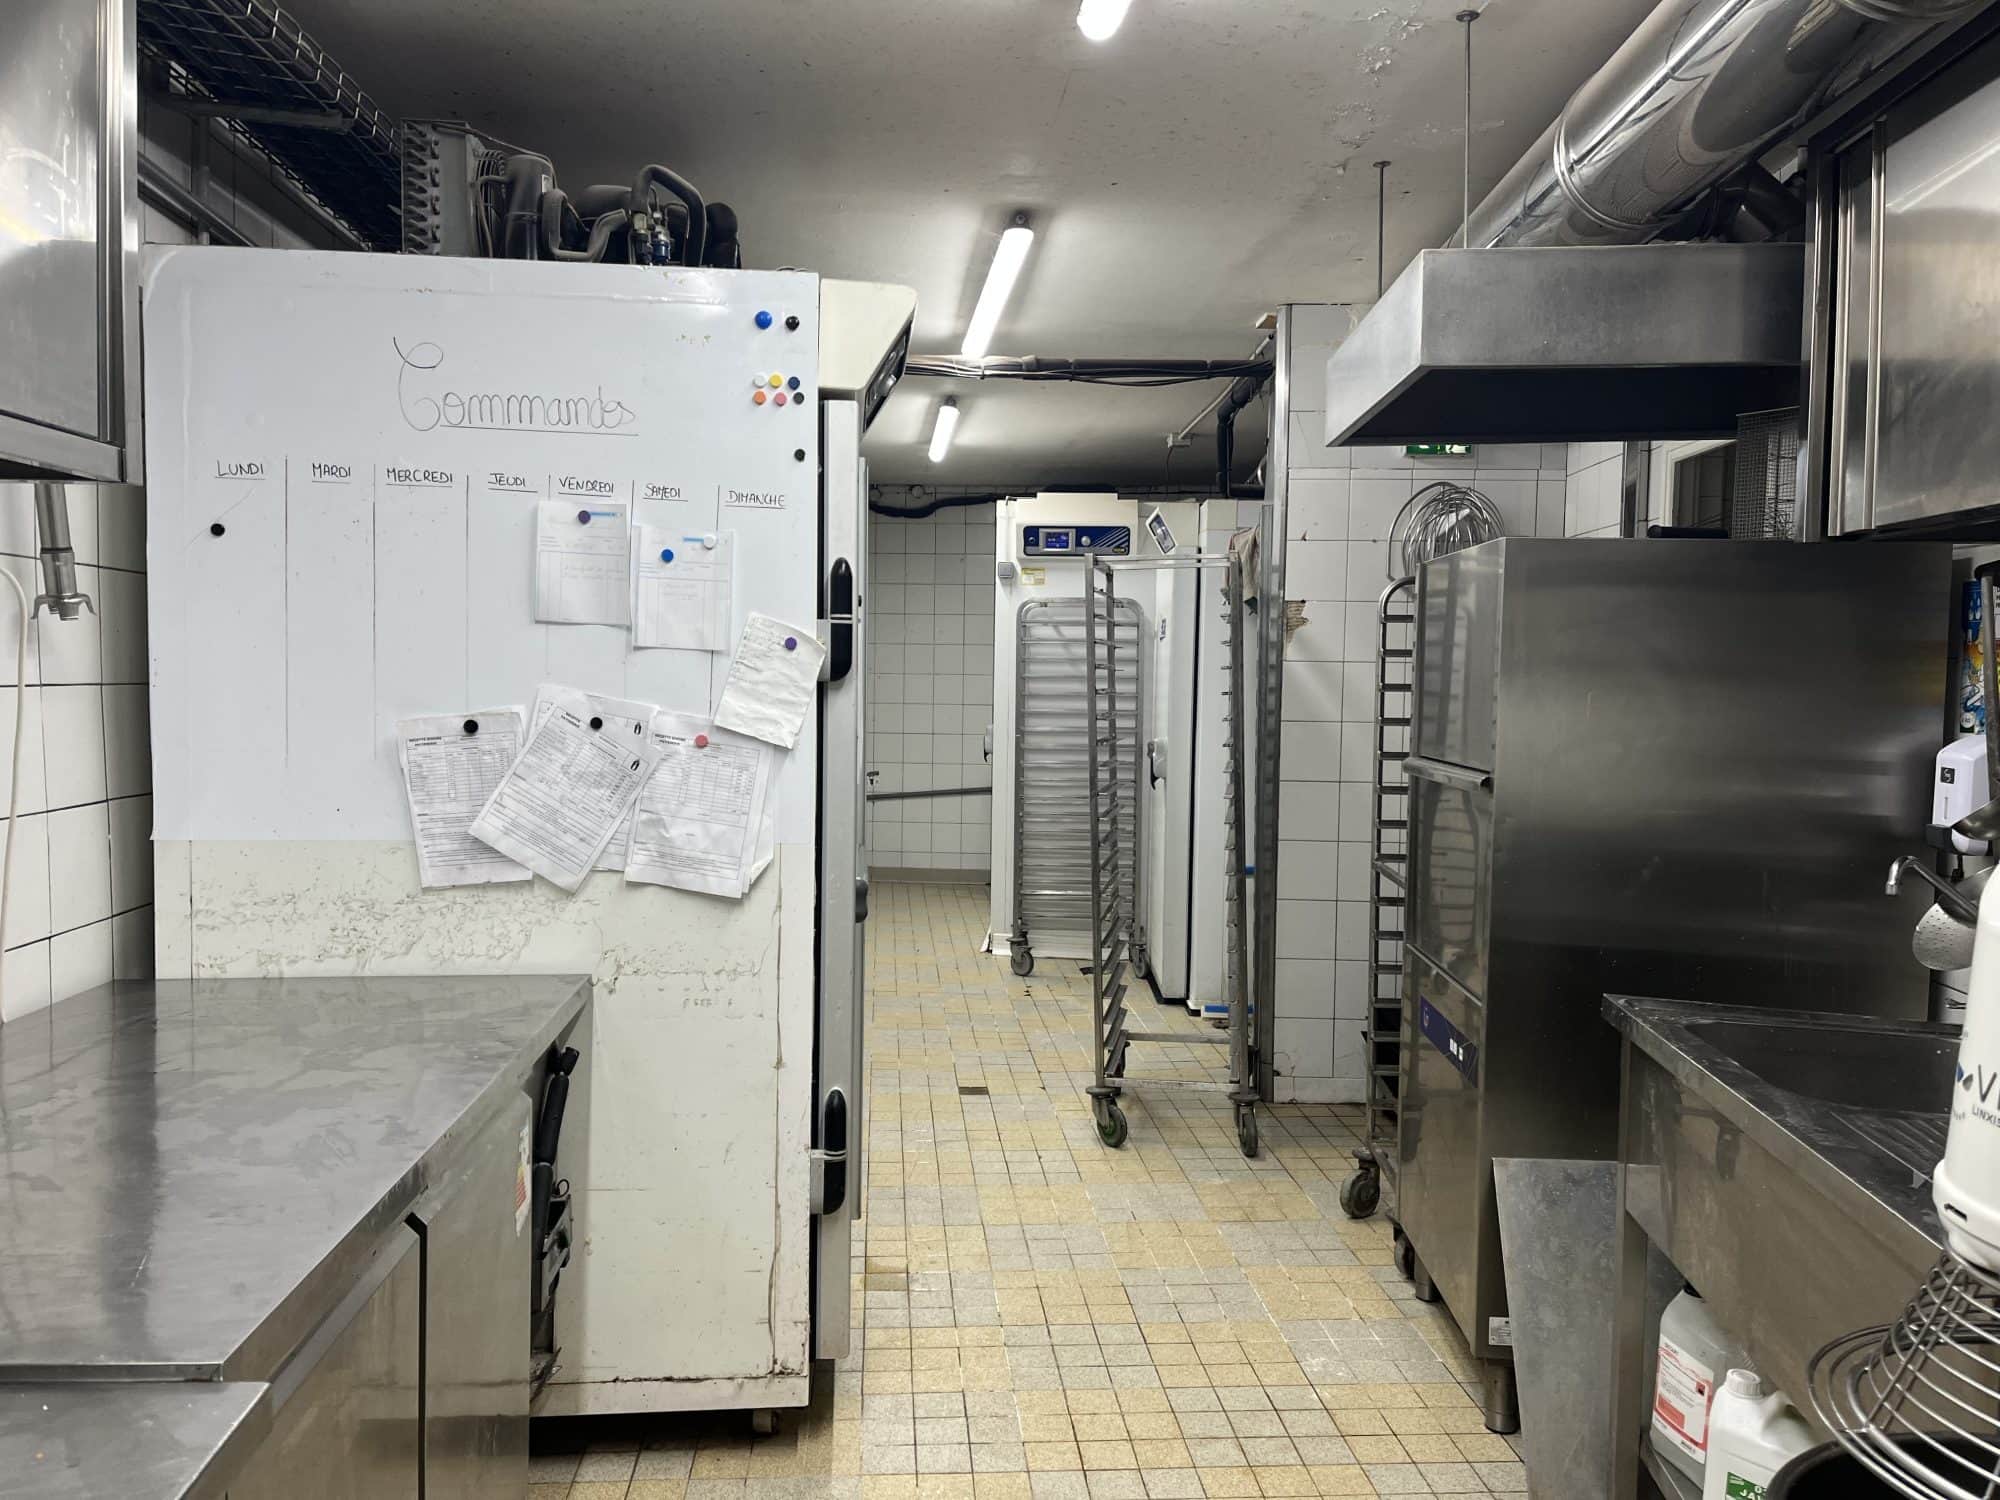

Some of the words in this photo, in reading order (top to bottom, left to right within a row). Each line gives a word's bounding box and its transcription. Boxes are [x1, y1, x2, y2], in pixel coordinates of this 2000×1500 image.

[216, 459, 265, 477] LUNDI
[311, 462, 352, 479] MARDI
[386, 467, 453, 484] MERCREDI
[487, 472, 526, 488] JEUDI
[558, 475, 615, 494] VENDREDI
[643, 482, 682, 500] SAMEDI
[726, 489, 786, 507] DIMANCHE
